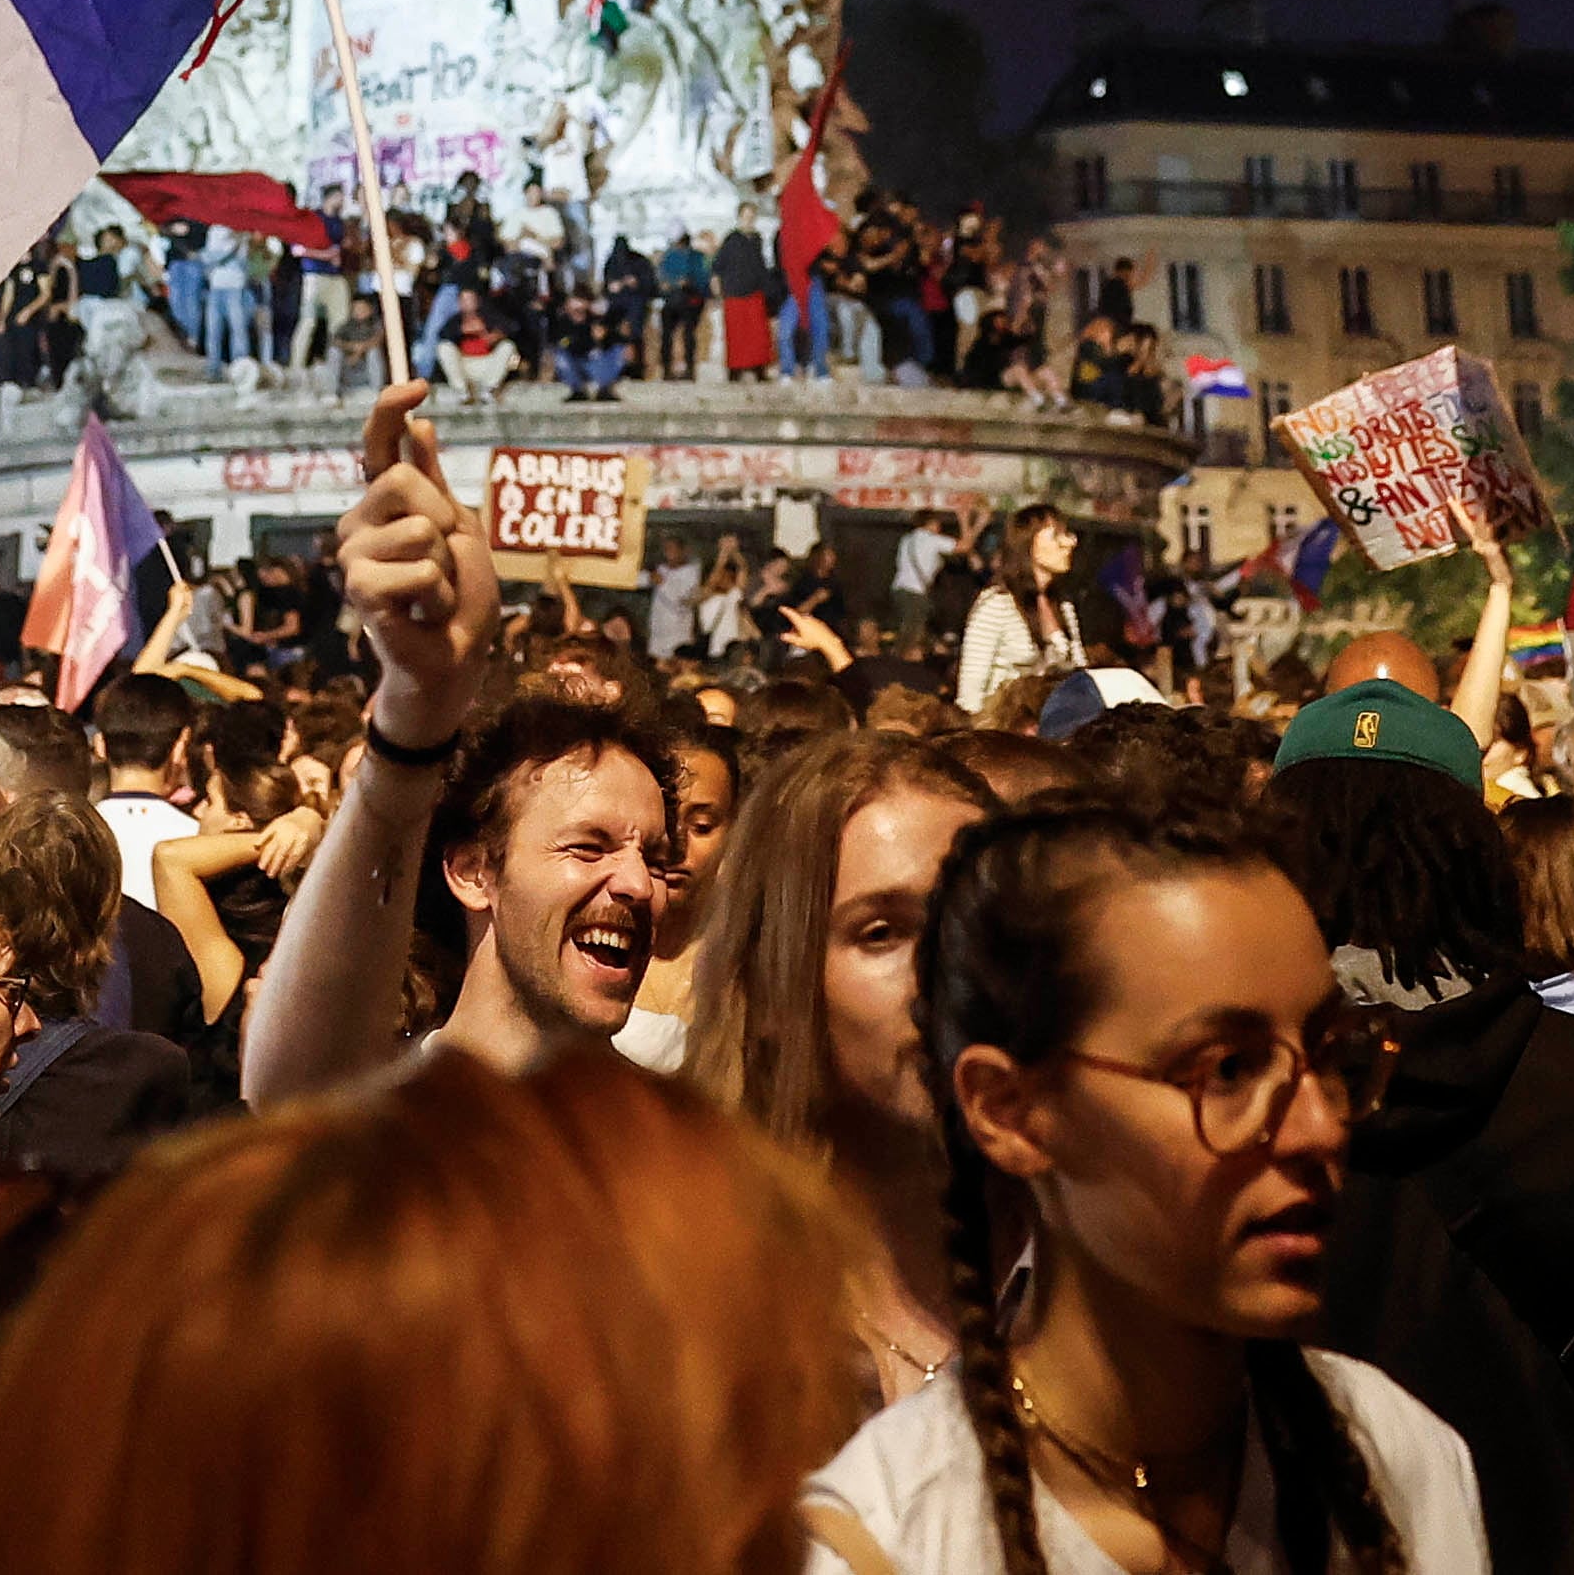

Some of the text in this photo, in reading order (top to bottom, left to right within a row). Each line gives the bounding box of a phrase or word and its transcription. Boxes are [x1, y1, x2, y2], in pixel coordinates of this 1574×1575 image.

[1302, 431, 1356, 469] NOS
[1349, 399, 1436, 451] DROITS
[1322, 456, 1368, 489] NOS
[1370, 428, 1460, 478] LUTTES
[1338, 486, 1382, 526] &
